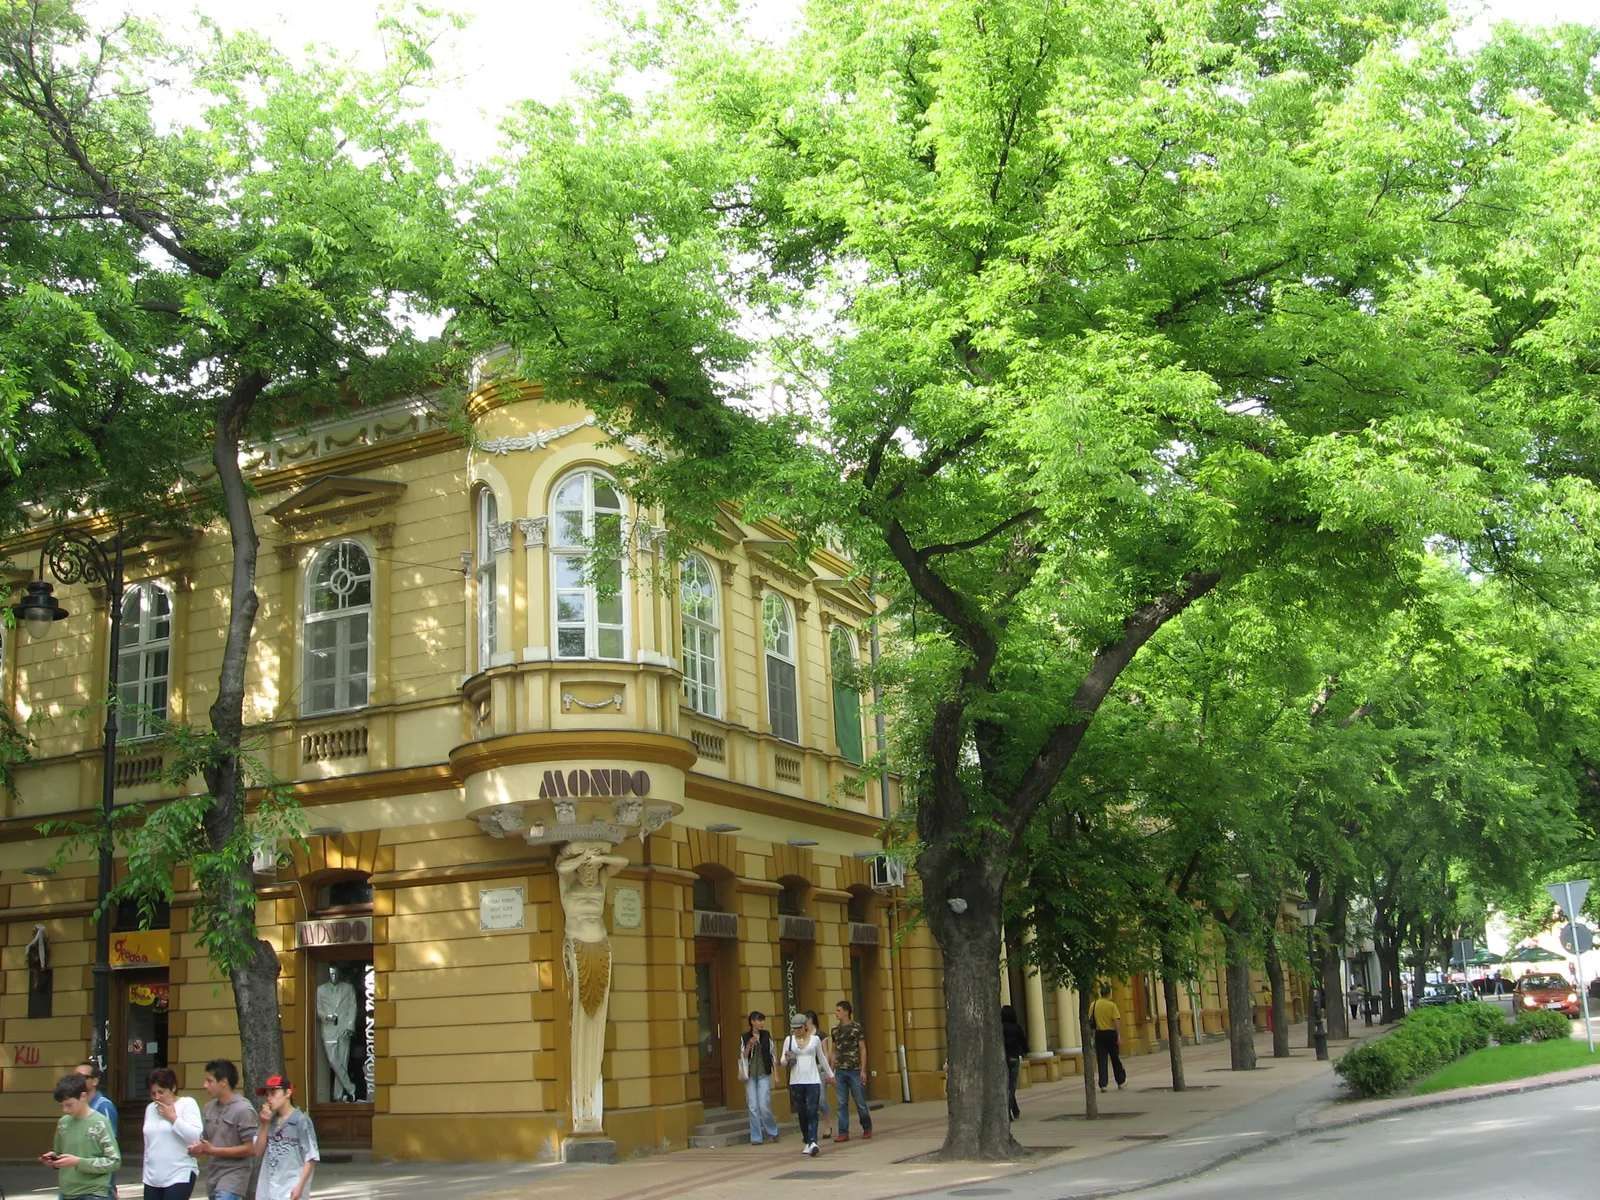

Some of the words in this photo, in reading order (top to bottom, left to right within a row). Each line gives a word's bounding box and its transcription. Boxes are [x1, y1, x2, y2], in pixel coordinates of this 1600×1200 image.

[539, 769, 650, 797] MONDO
[301, 920, 367, 945] MONDO
[786, 960, 795, 999] Nova
